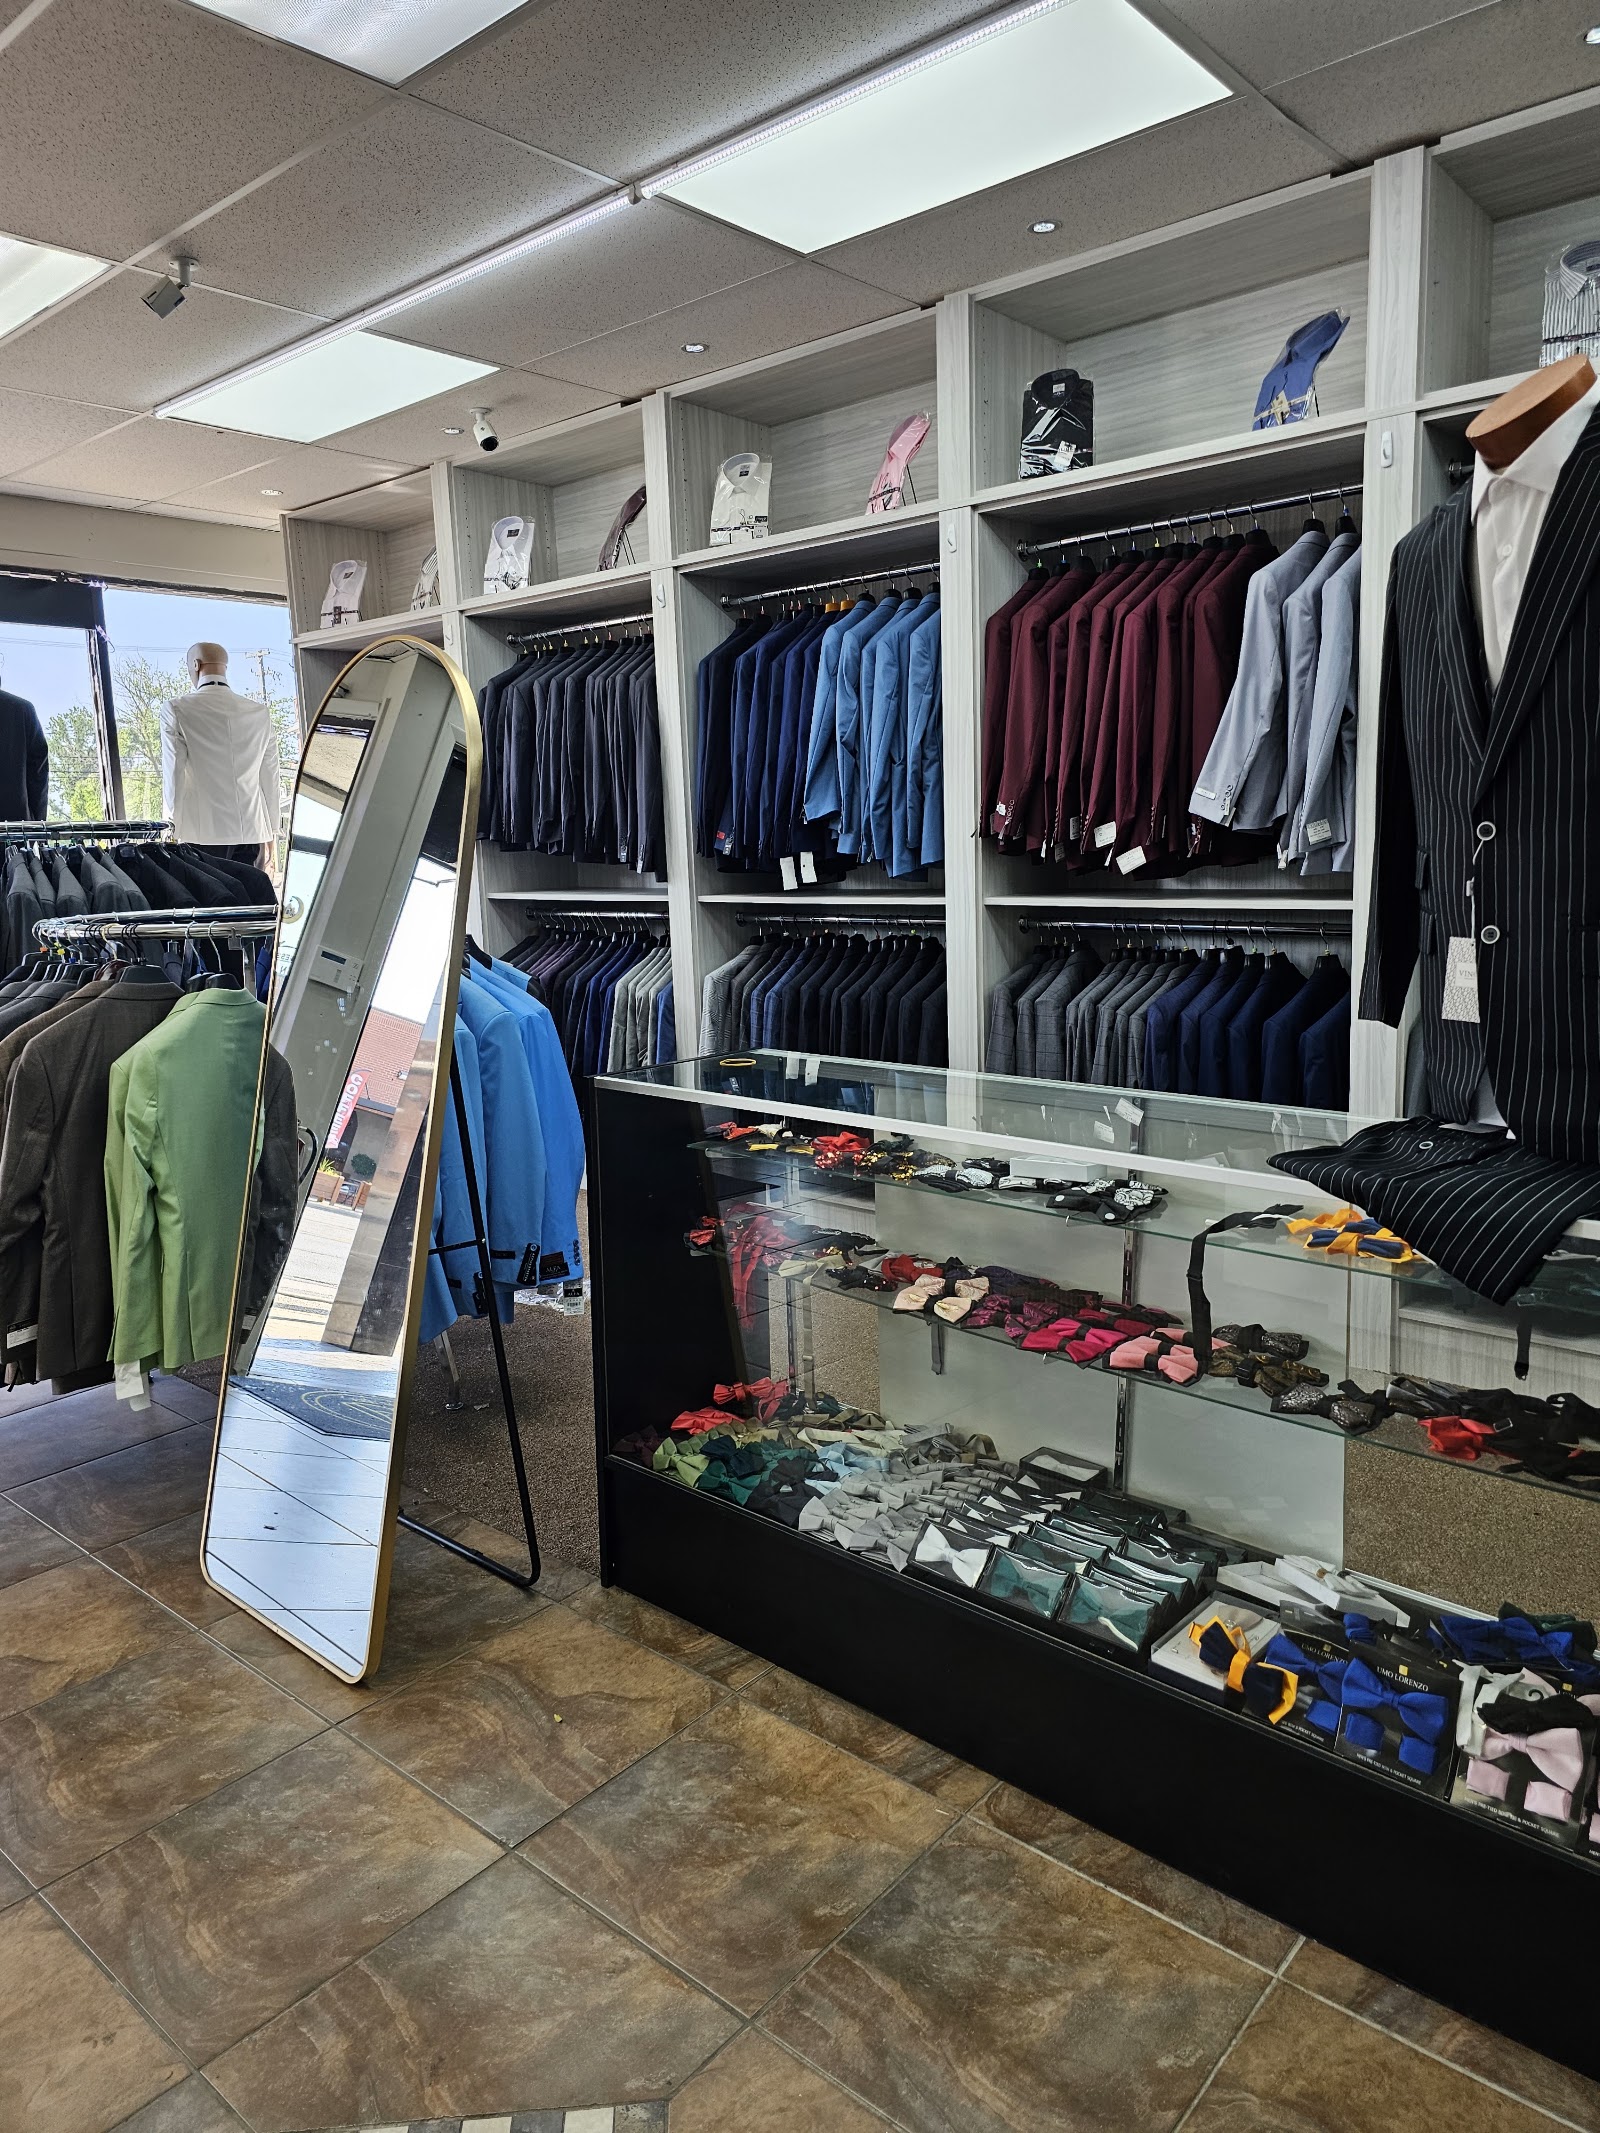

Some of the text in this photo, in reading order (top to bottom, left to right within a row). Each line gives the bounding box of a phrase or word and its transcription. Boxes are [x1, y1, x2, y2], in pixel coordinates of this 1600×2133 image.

[1301, 1643, 1317, 1653] UMO
[1376, 1665, 1429, 1692] UMO LORENZO
[1393, 1769, 1407, 1779] POCKET
[1406, 1775, 1422, 1786] SQUARE
[1521, 1818, 1540, 1830] POCKET
[1540, 1826, 1560, 1838] SQUARE
